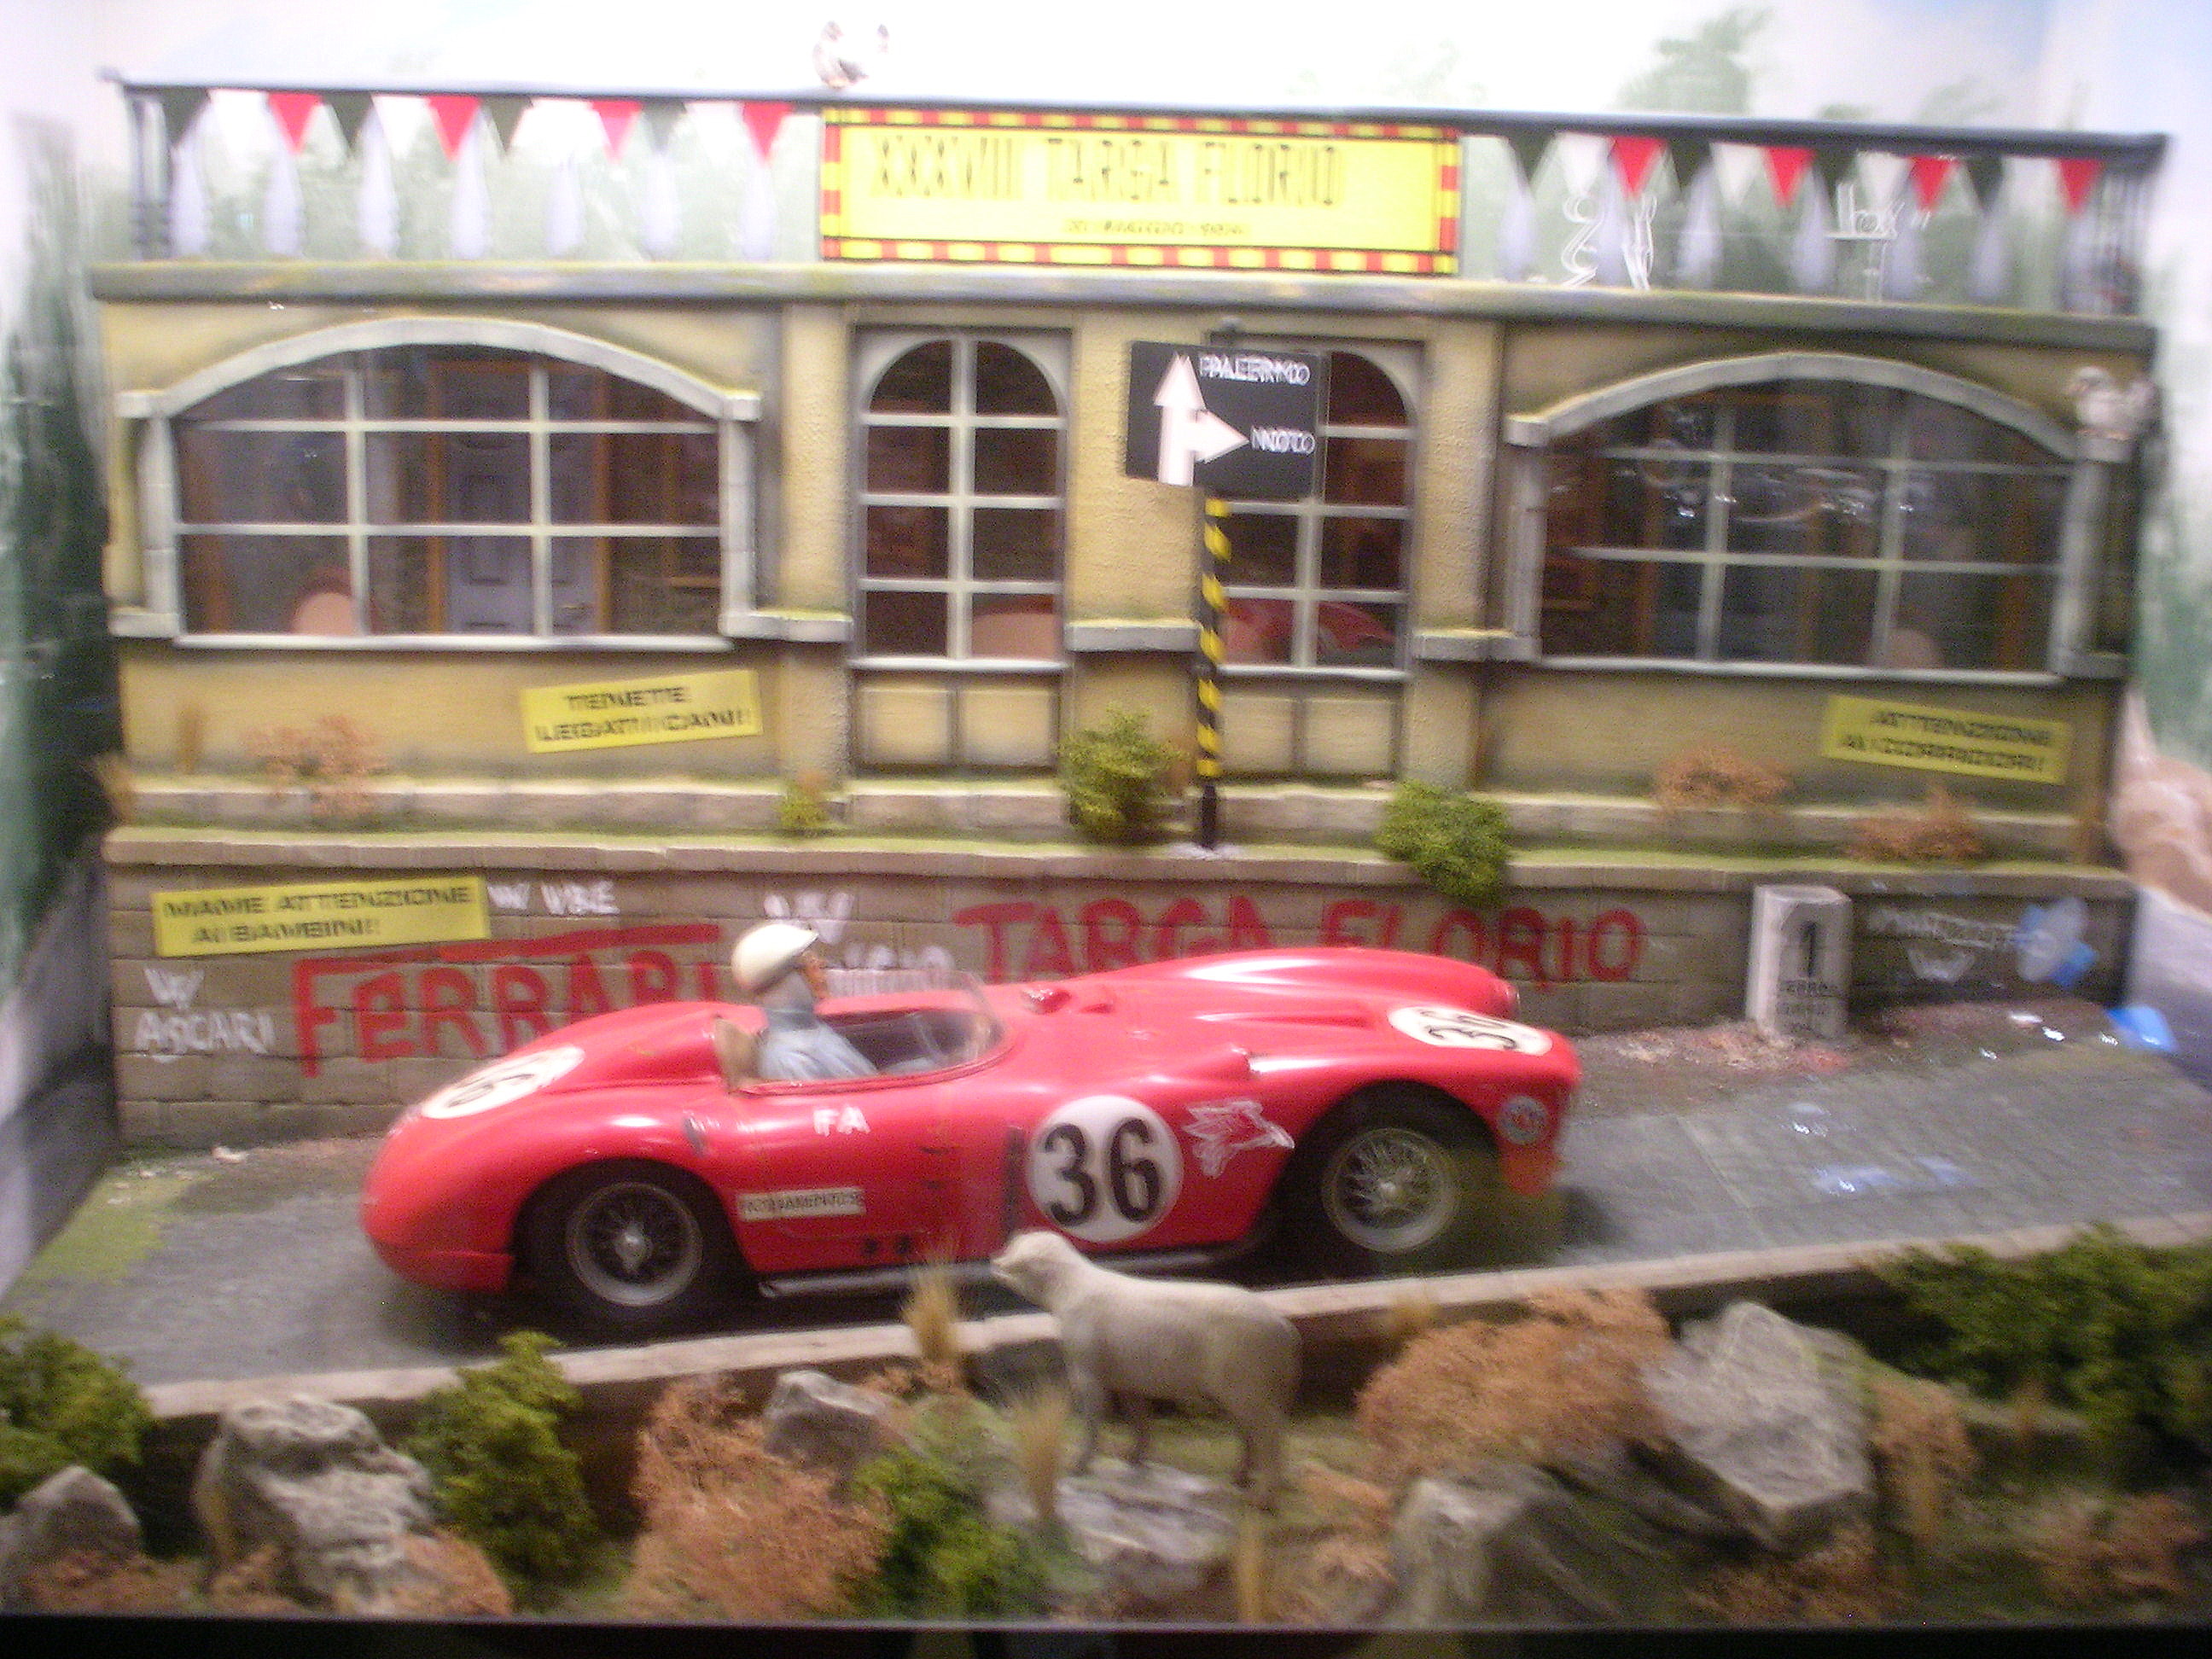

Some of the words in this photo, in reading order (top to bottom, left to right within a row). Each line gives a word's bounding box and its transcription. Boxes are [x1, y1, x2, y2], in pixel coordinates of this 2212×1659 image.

[1200, 355, 1311, 385] PALERMO
[1251, 427, 1316, 456] NOTO
[565, 685, 685, 710] TENETE
[277, 886, 473, 911] ATTENZIONE
[1044, 1117, 1161, 1227] 36
